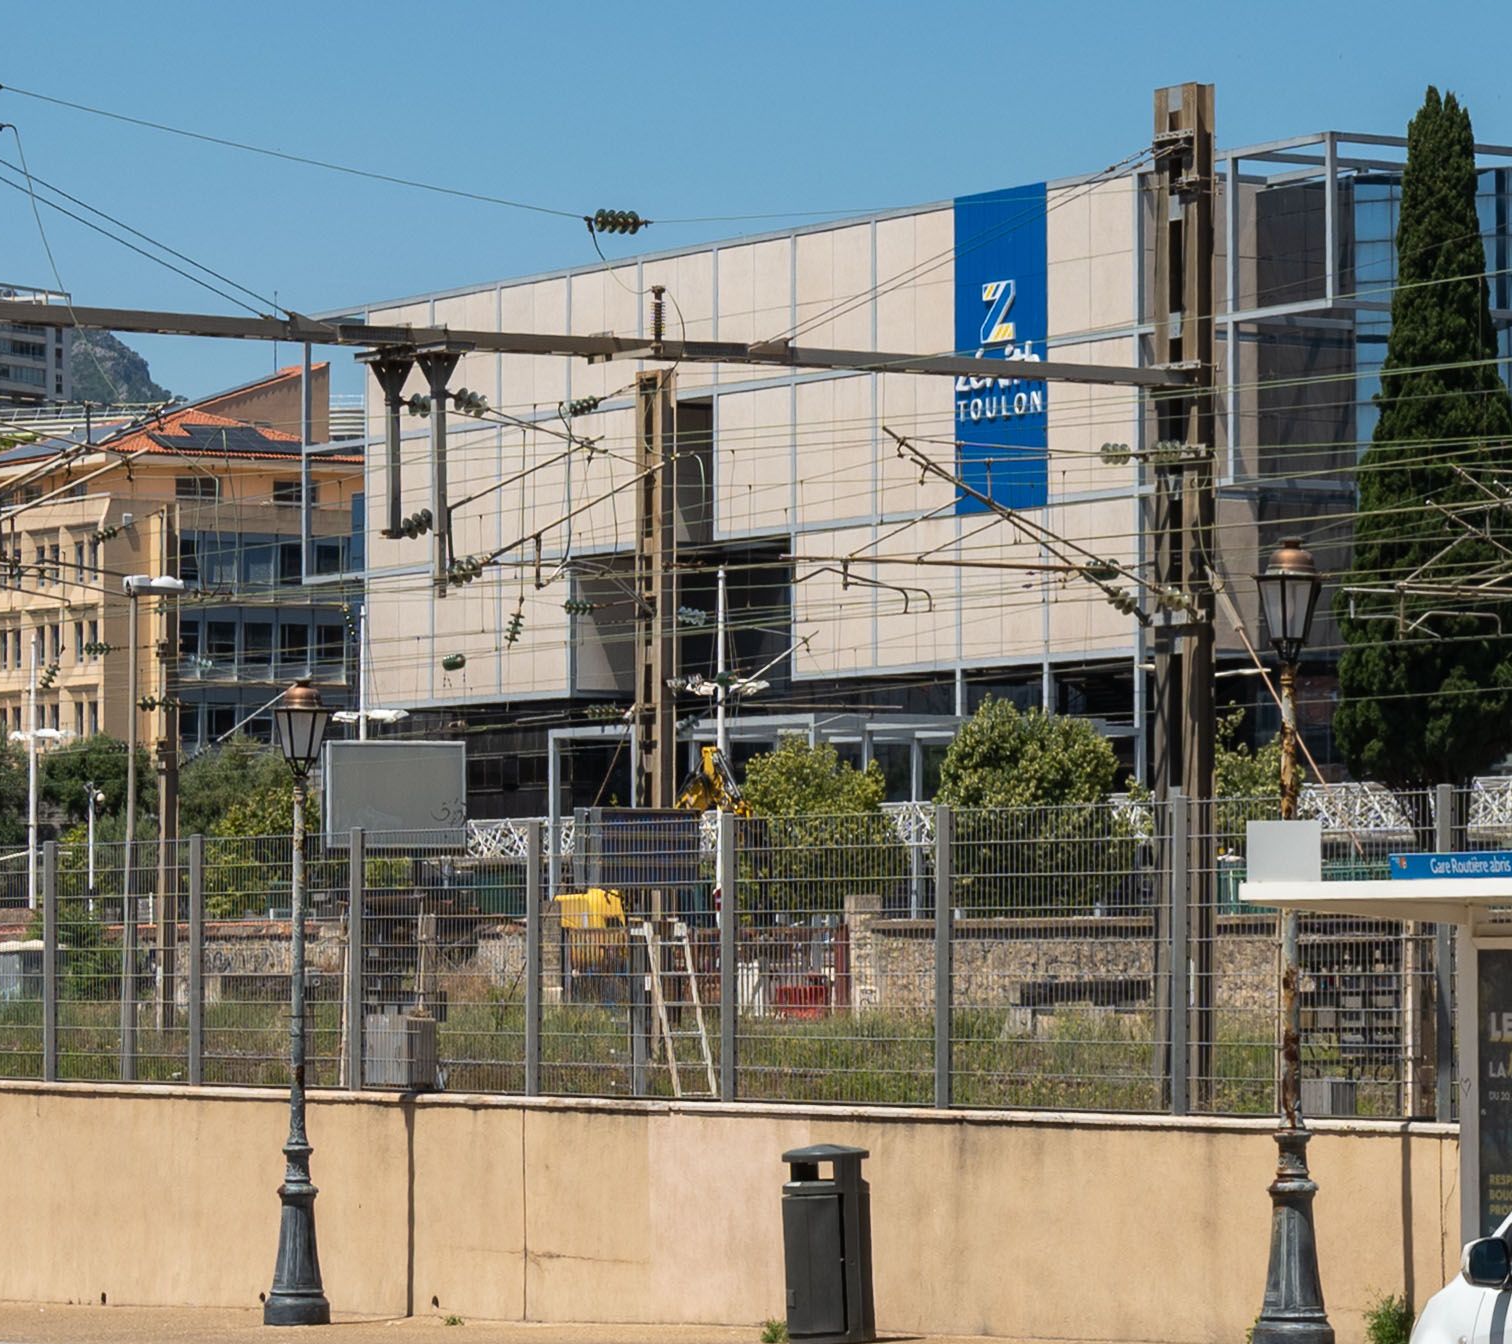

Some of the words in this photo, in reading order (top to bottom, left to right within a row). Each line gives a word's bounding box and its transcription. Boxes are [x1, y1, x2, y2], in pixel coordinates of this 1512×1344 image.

[956, 390, 1043, 423] TOULON
[1430, 858, 1450, 874] Gare
[1452, 857, 1488, 874] Routière
[1489, 856, 1511, 873] abris
[1489, 1061, 1507, 1078] LA
